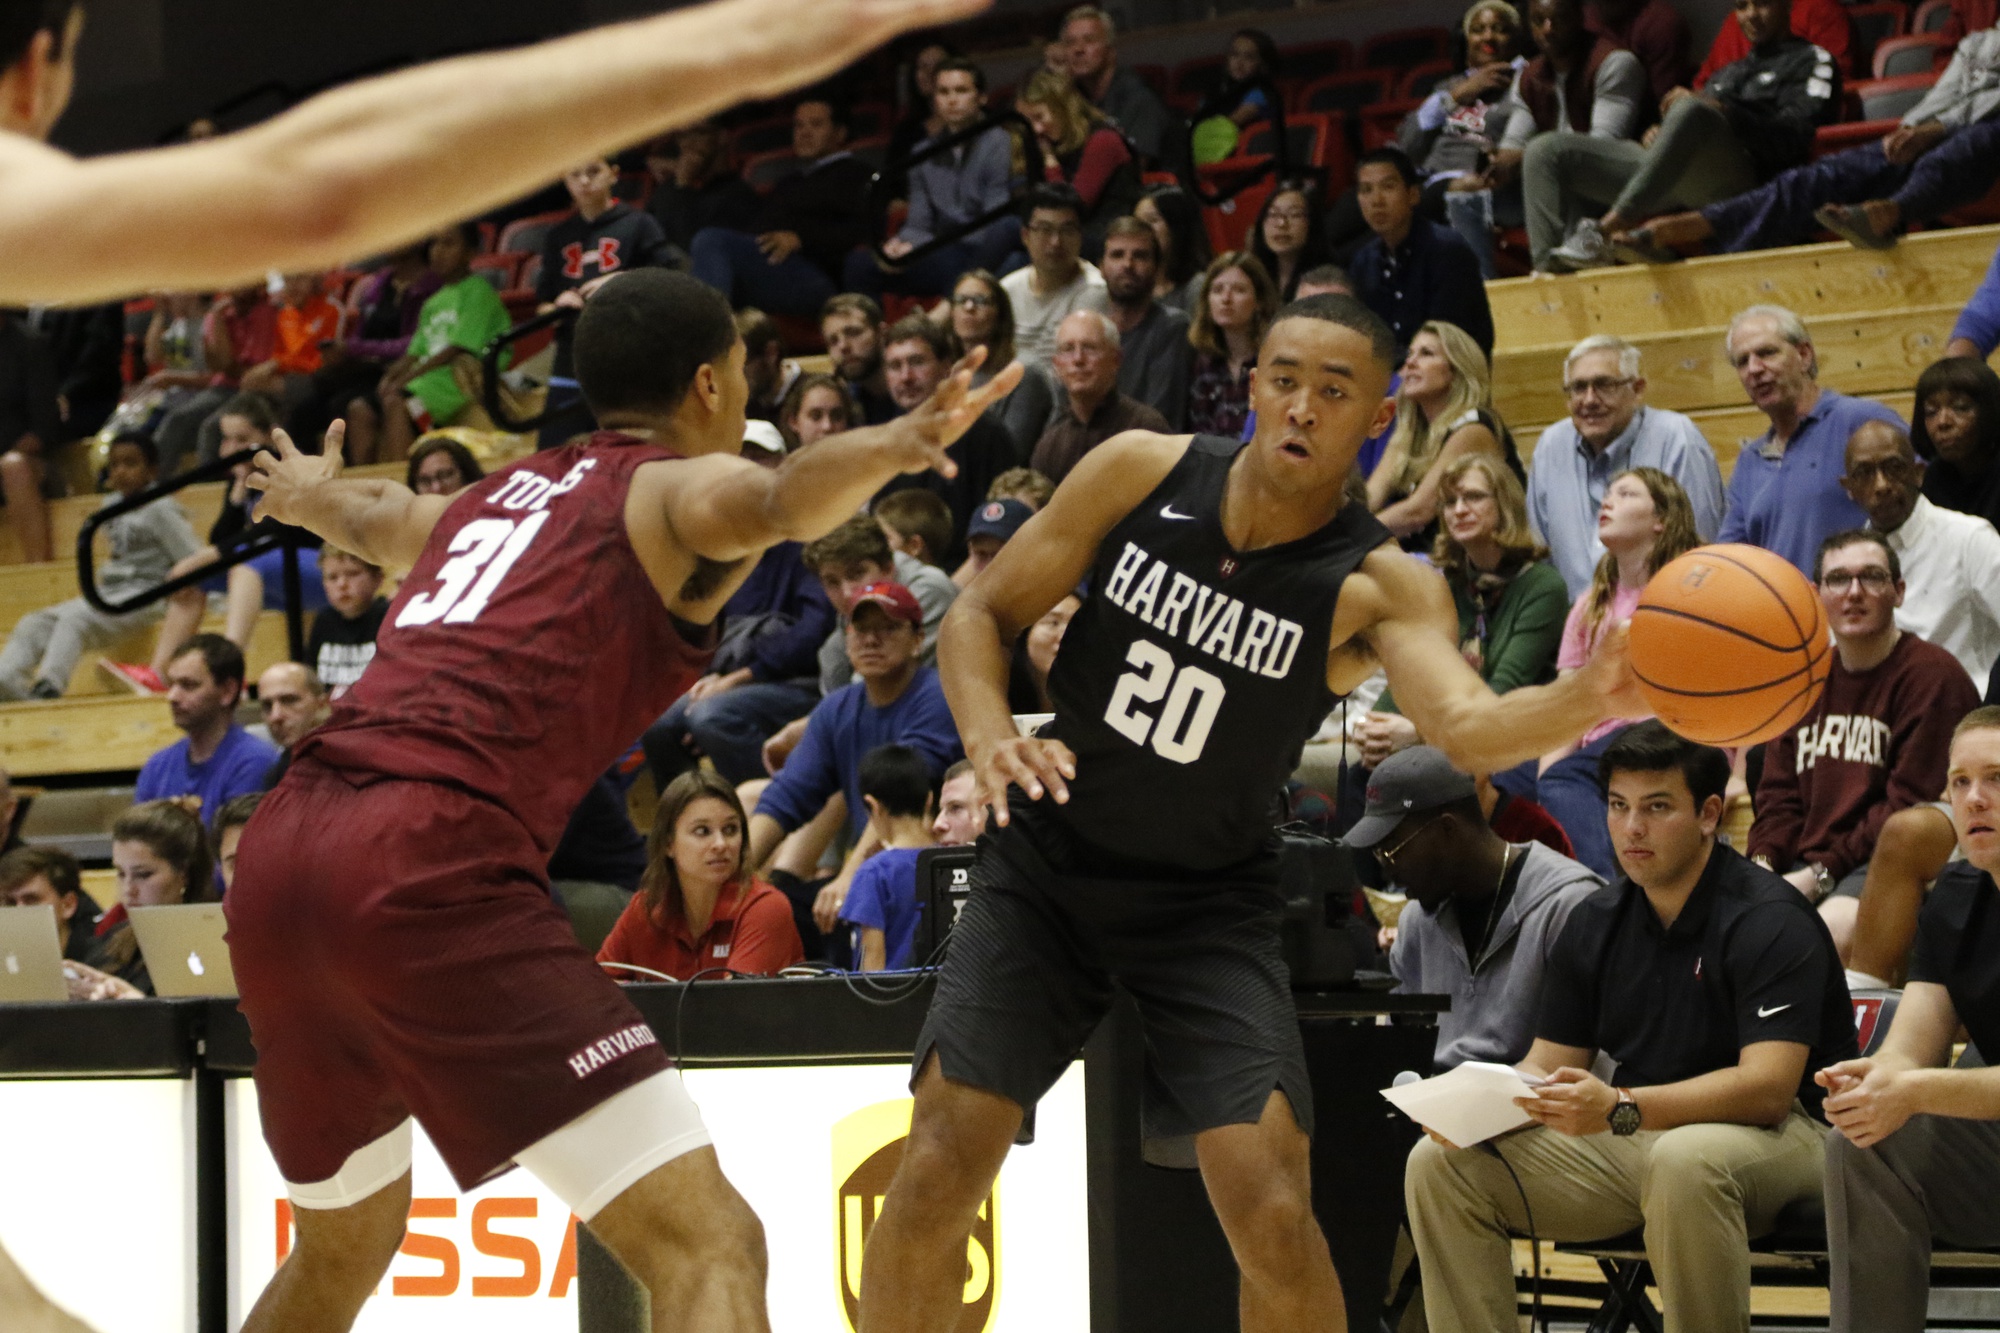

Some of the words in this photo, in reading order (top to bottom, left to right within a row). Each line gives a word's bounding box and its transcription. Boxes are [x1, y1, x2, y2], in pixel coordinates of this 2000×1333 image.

[395, 510, 550, 628] 31
[1104, 541, 1304, 679] HARVARD
[1103, 638, 1226, 764] 20
[568, 1024, 656, 1078] HARVARD
